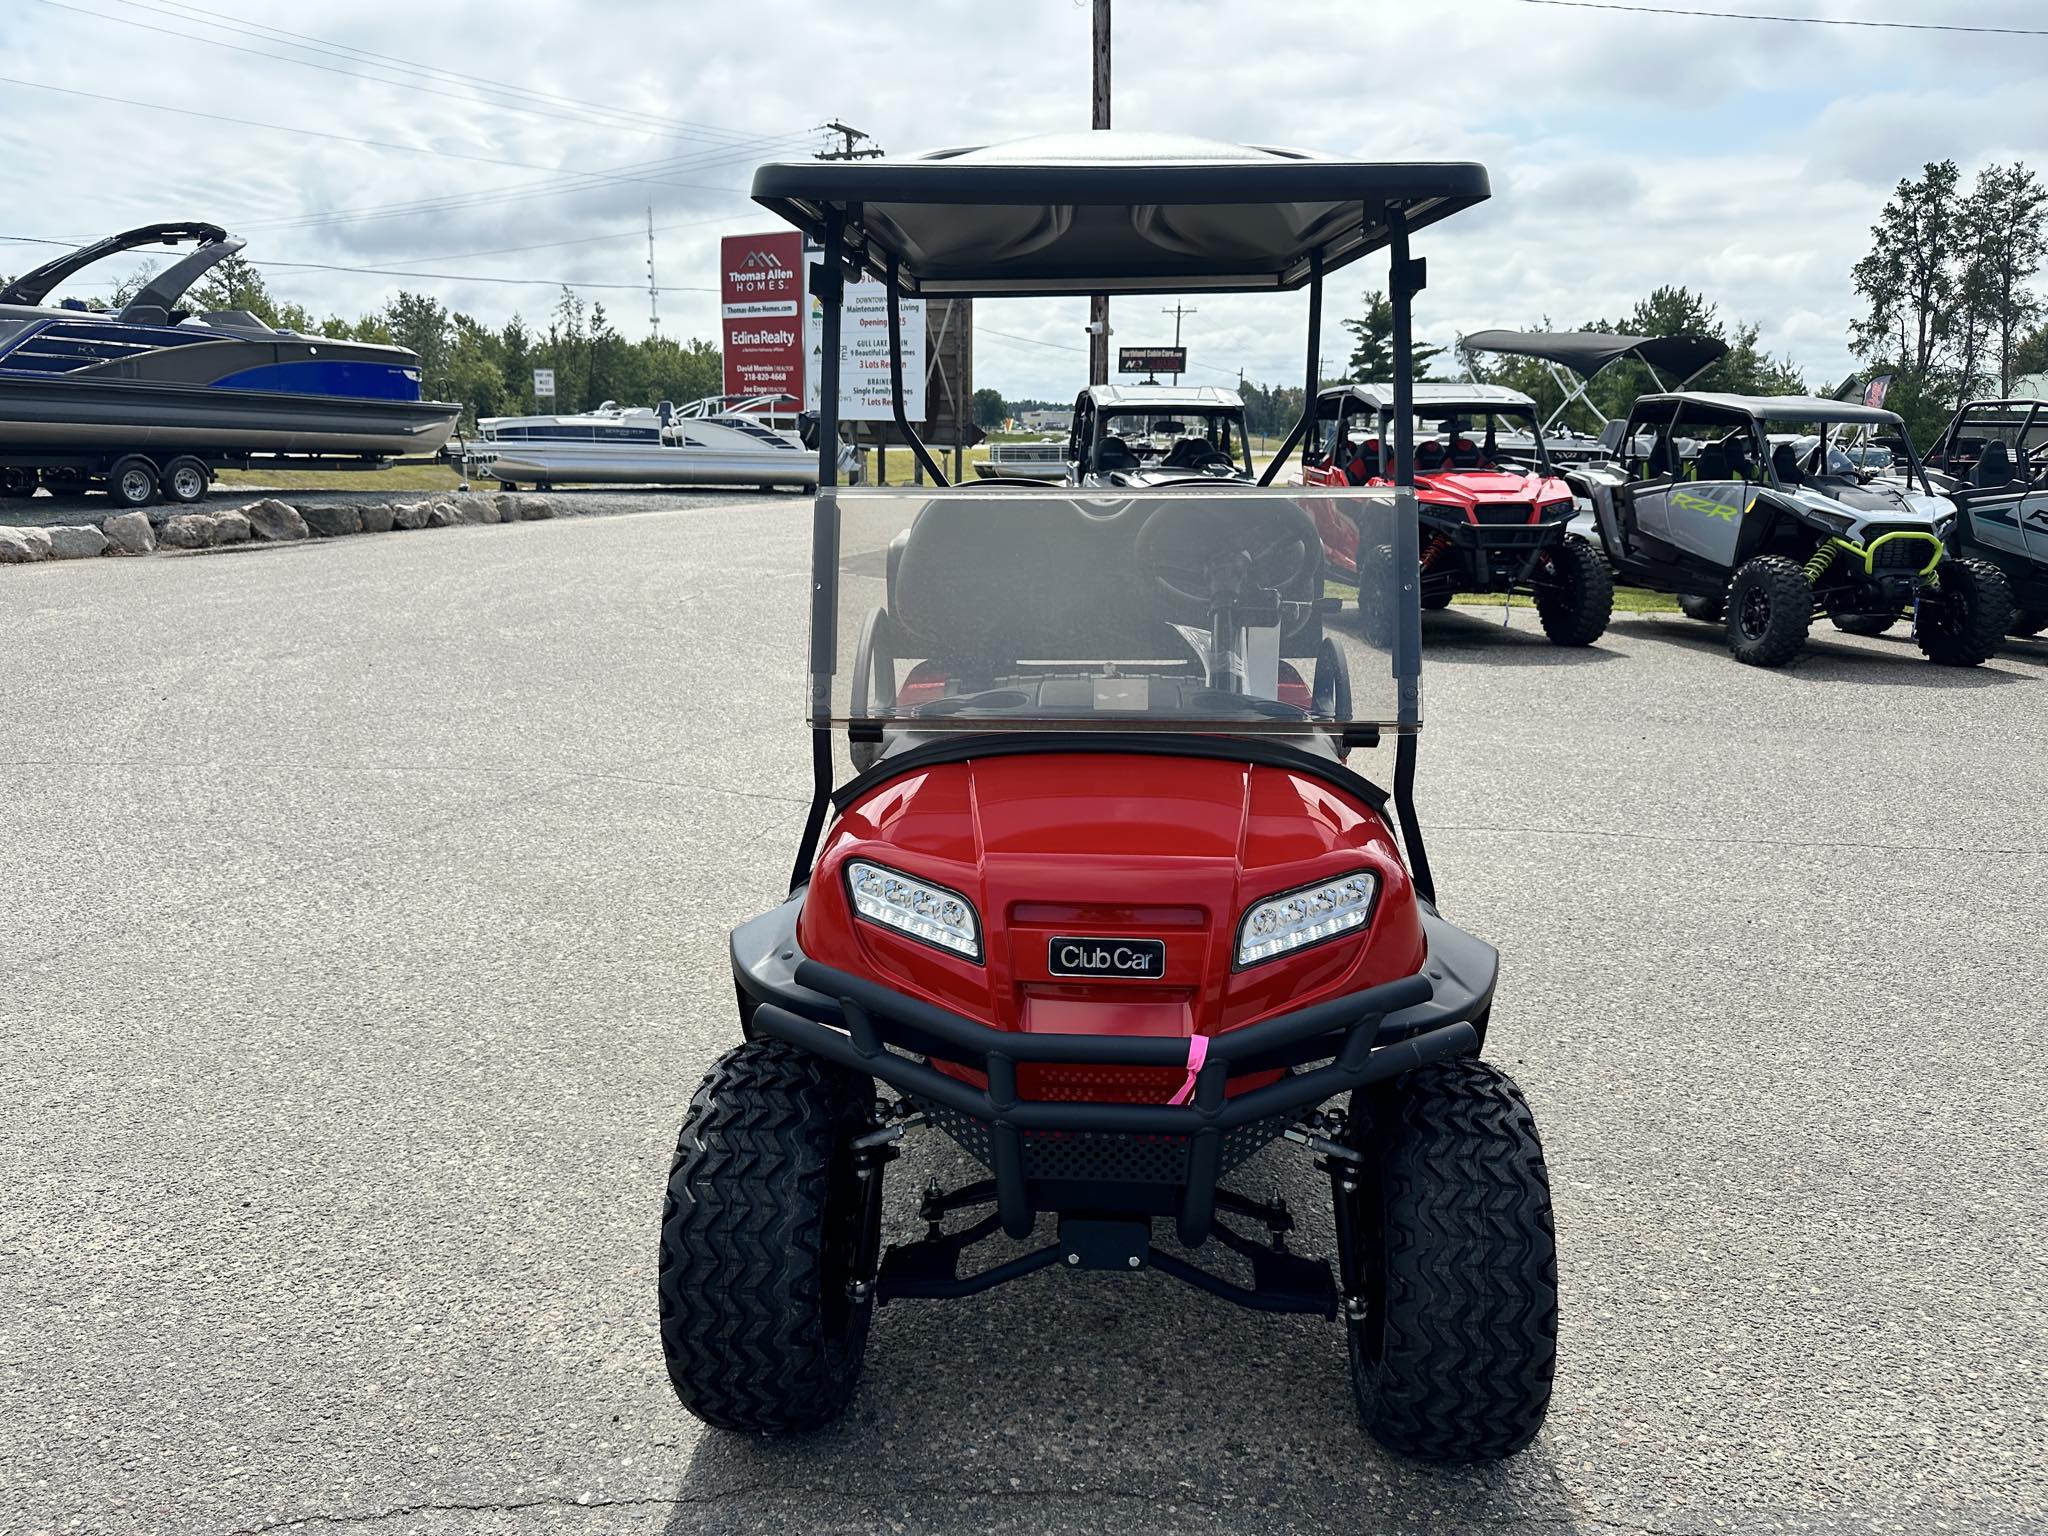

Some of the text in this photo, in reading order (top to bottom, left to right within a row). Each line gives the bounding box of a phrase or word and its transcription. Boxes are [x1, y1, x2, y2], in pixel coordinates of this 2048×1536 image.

[729, 269, 793, 281] Thomas Allen
[736, 280, 784, 292] HOMES
[900, 304, 919, 313] Living
[860, 318, 888, 328] Opening
[873, 339, 888, 347] LAKE
[855, 349, 880, 357] Beautiful
[859, 360, 864, 368] 3
[865, 360, 879, 368] Lots
[853, 387, 871, 396] Single
[872, 387, 891, 396] Family
[867, 398, 881, 406] Lots
[1670, 492, 1738, 522] RZR
[1060, 945, 1153, 970] Club Car
